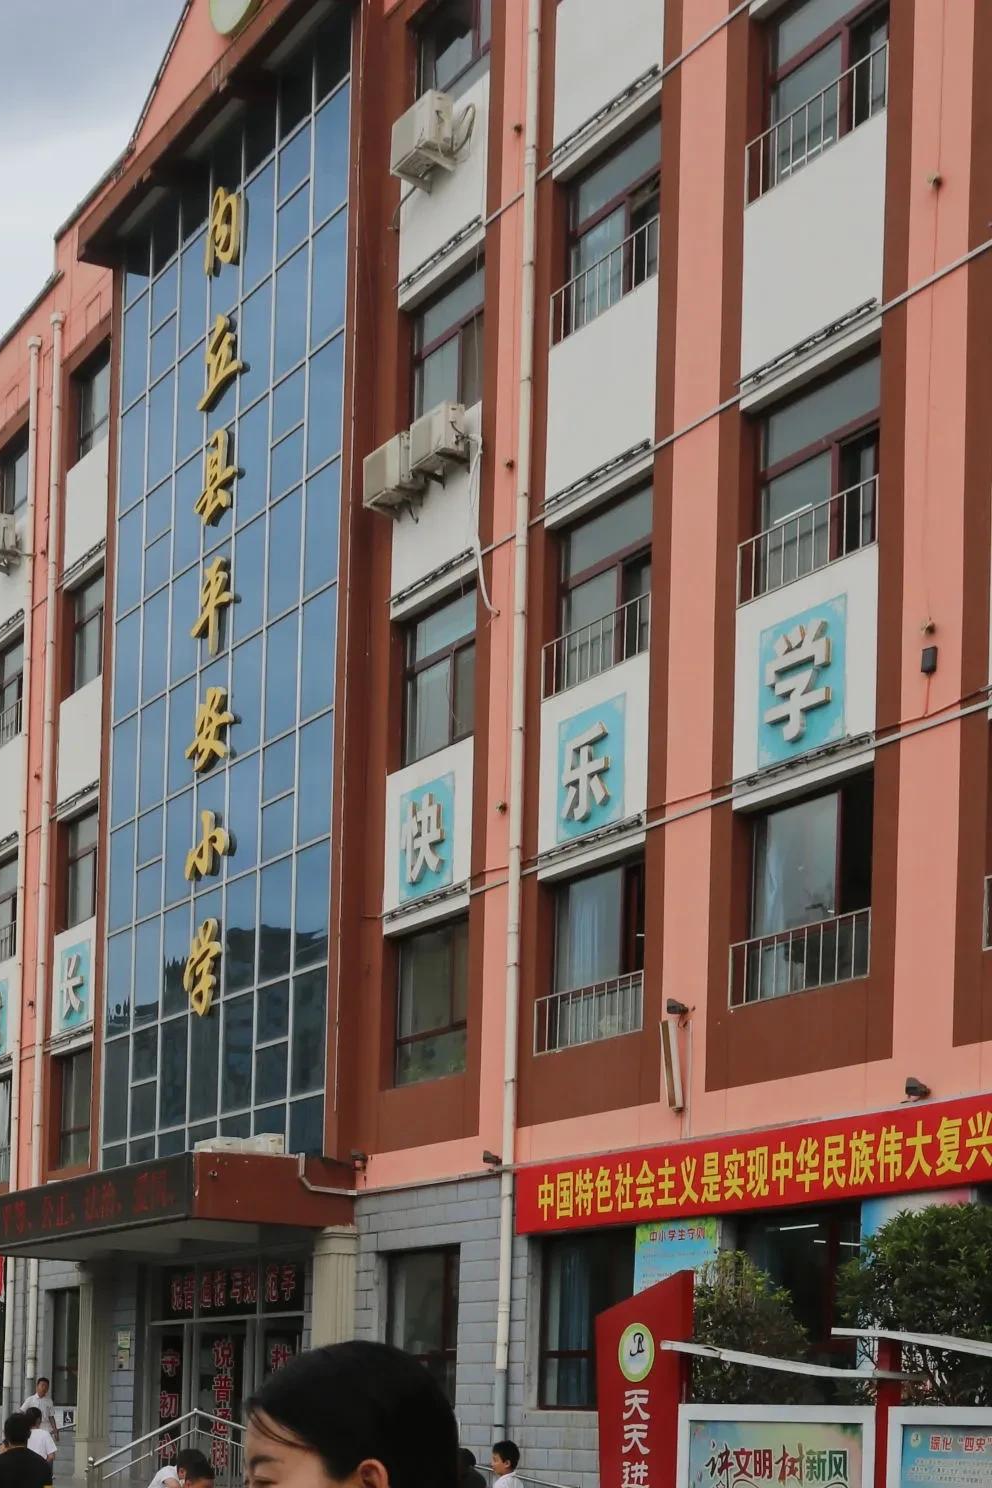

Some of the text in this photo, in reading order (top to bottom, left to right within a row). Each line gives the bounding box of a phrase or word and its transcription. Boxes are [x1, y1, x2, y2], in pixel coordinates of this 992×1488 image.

[181, 186, 247, 1018] 内丘县平安小学
[537, 1110, 992, 1221] 中国特色社会主义是实现中华民族伟大复兴
[649, 1226, 705, 1242] 中小学生守则
